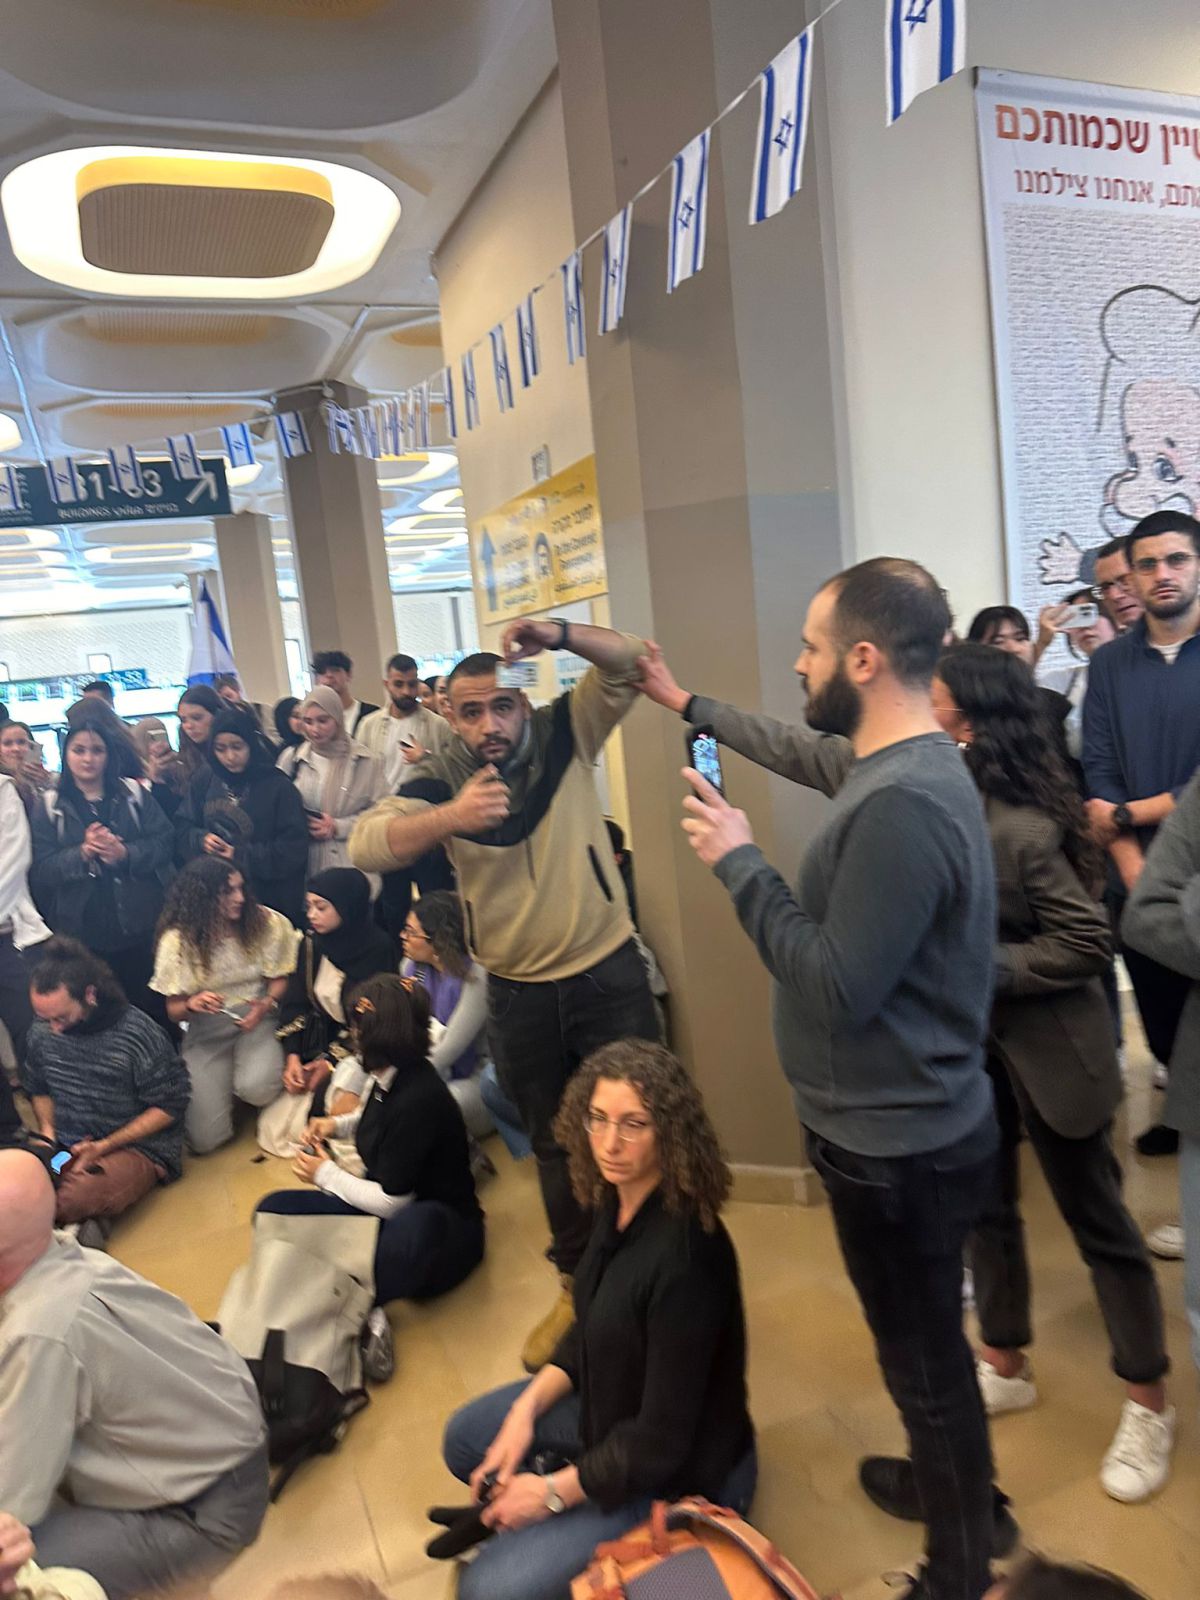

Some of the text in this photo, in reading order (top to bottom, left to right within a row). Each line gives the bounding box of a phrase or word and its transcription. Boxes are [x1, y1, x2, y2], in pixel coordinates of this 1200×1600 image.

[995, 104, 1150, 153] שכמותכם
[1014, 167, 1089, 198] צילמנו
[1094, 176, 1154, 204] אנחנו
